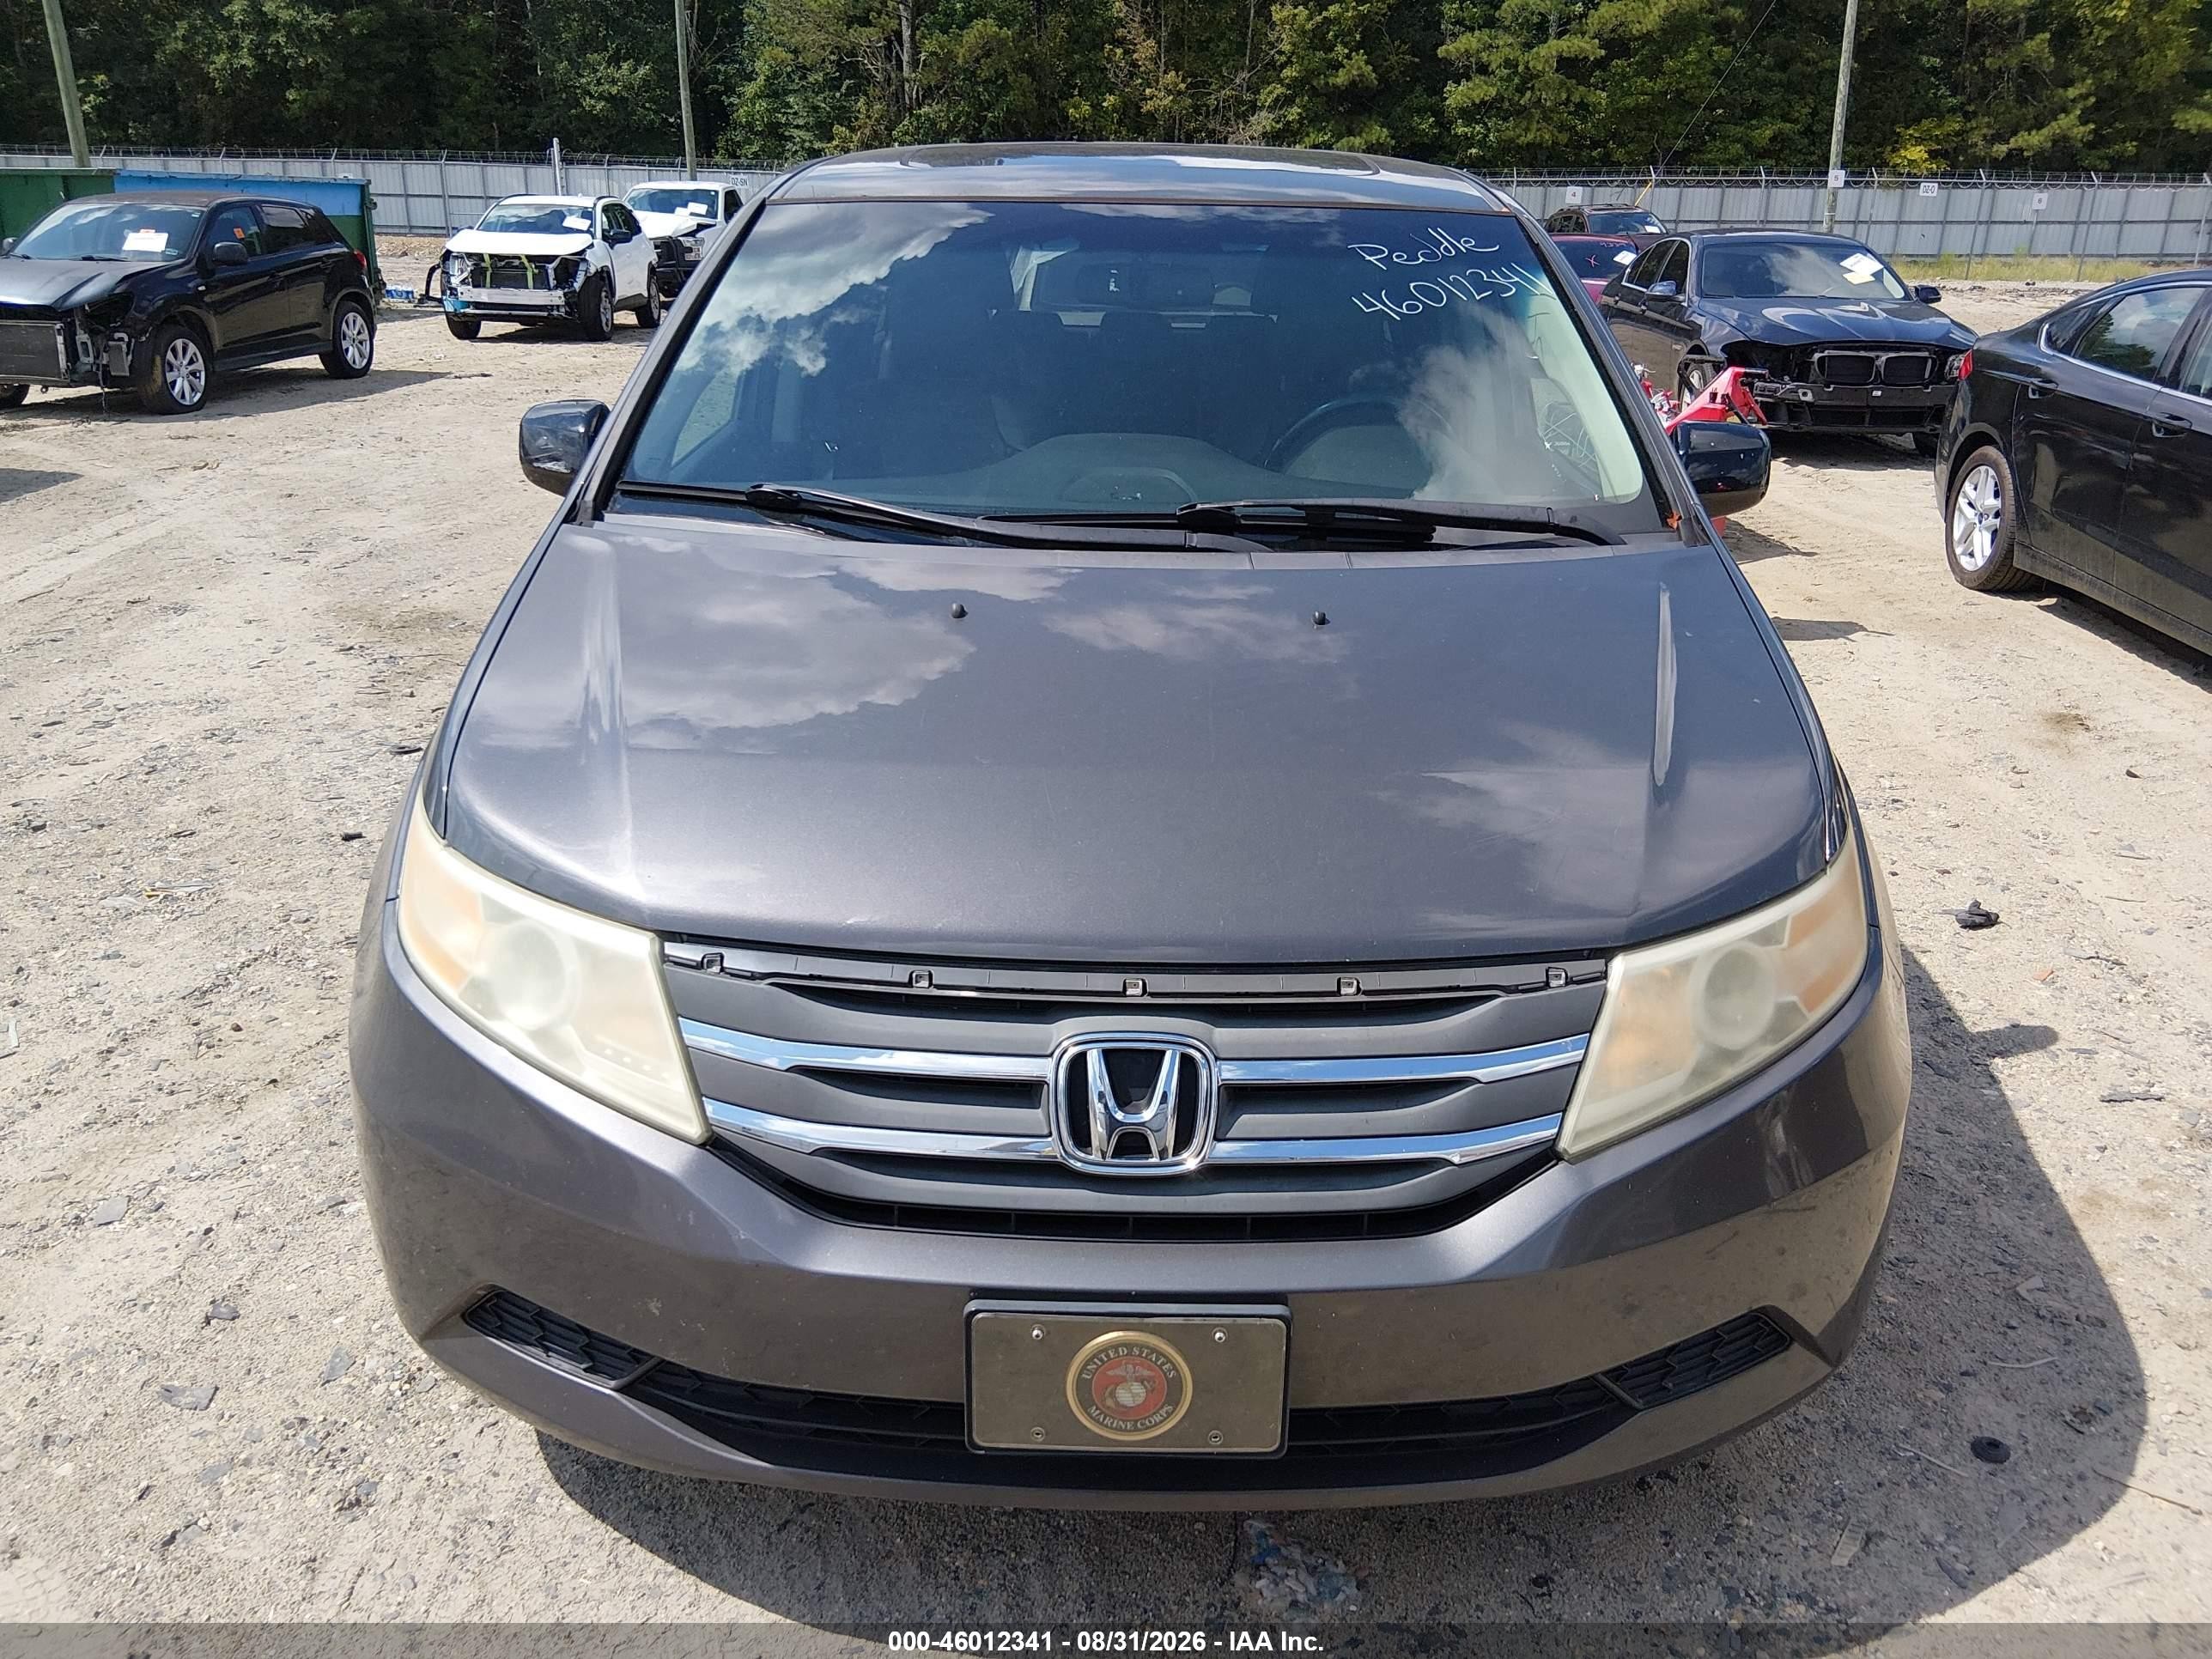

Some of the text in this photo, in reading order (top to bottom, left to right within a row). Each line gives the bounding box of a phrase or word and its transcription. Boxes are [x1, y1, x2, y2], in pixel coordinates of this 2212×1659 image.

[1347, 227, 1500, 270] Peddle
[1351, 263, 1554, 320] 46012341
[1082, 1346, 1176, 1380] UNITED STATES
[1087, 1404, 1175, 1431] MARINE CORPS
